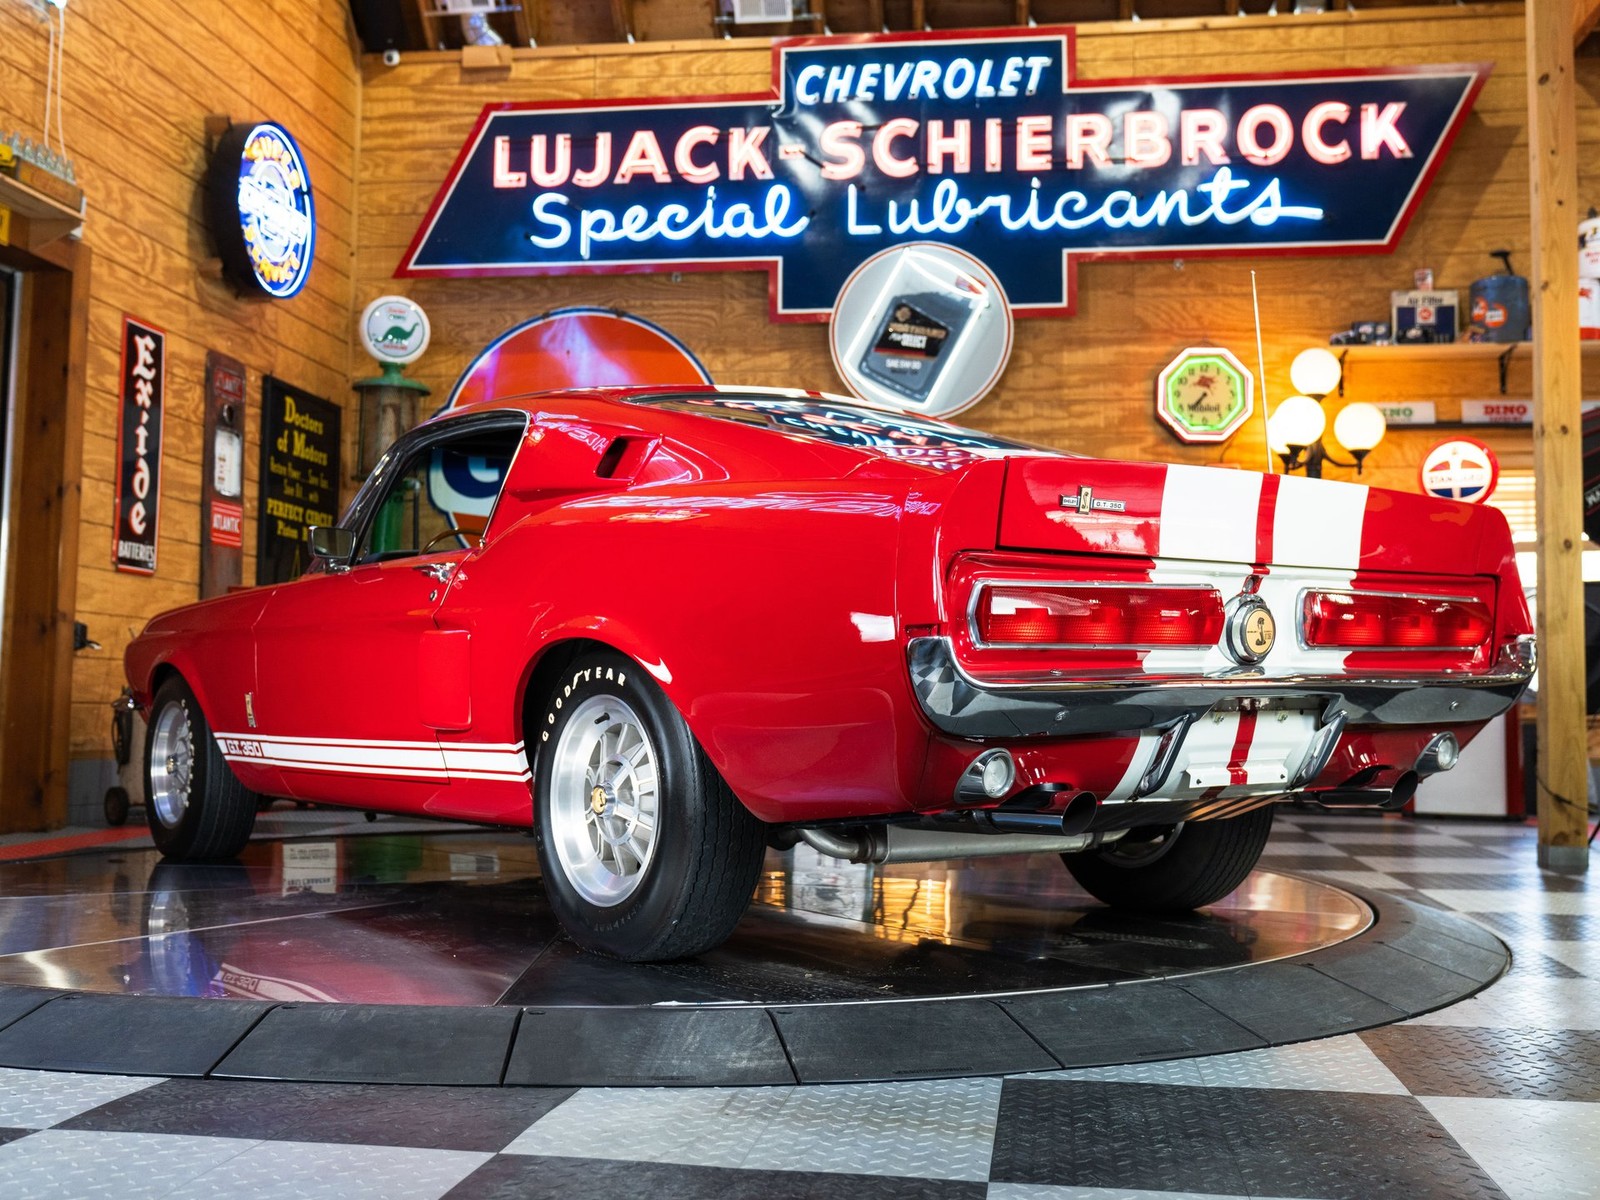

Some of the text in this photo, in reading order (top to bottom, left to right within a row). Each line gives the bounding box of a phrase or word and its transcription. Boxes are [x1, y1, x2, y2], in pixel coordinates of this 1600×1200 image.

[795, 56, 1053, 106] CHEVROLET
[529, 165, 1324, 260] Special Lubricants
[283, 395, 324, 435] Doctors
[1483, 404, 1528, 417] DINO
[131, 334, 156, 535] Exide
[276, 429, 328, 467] of Motors
[212, 513, 241, 535] ATLANTIC
[266, 497, 304, 523] PERFECT
[118, 540, 155, 562] BATTERIES
[541, 666, 627, 742] GOODYEAR
